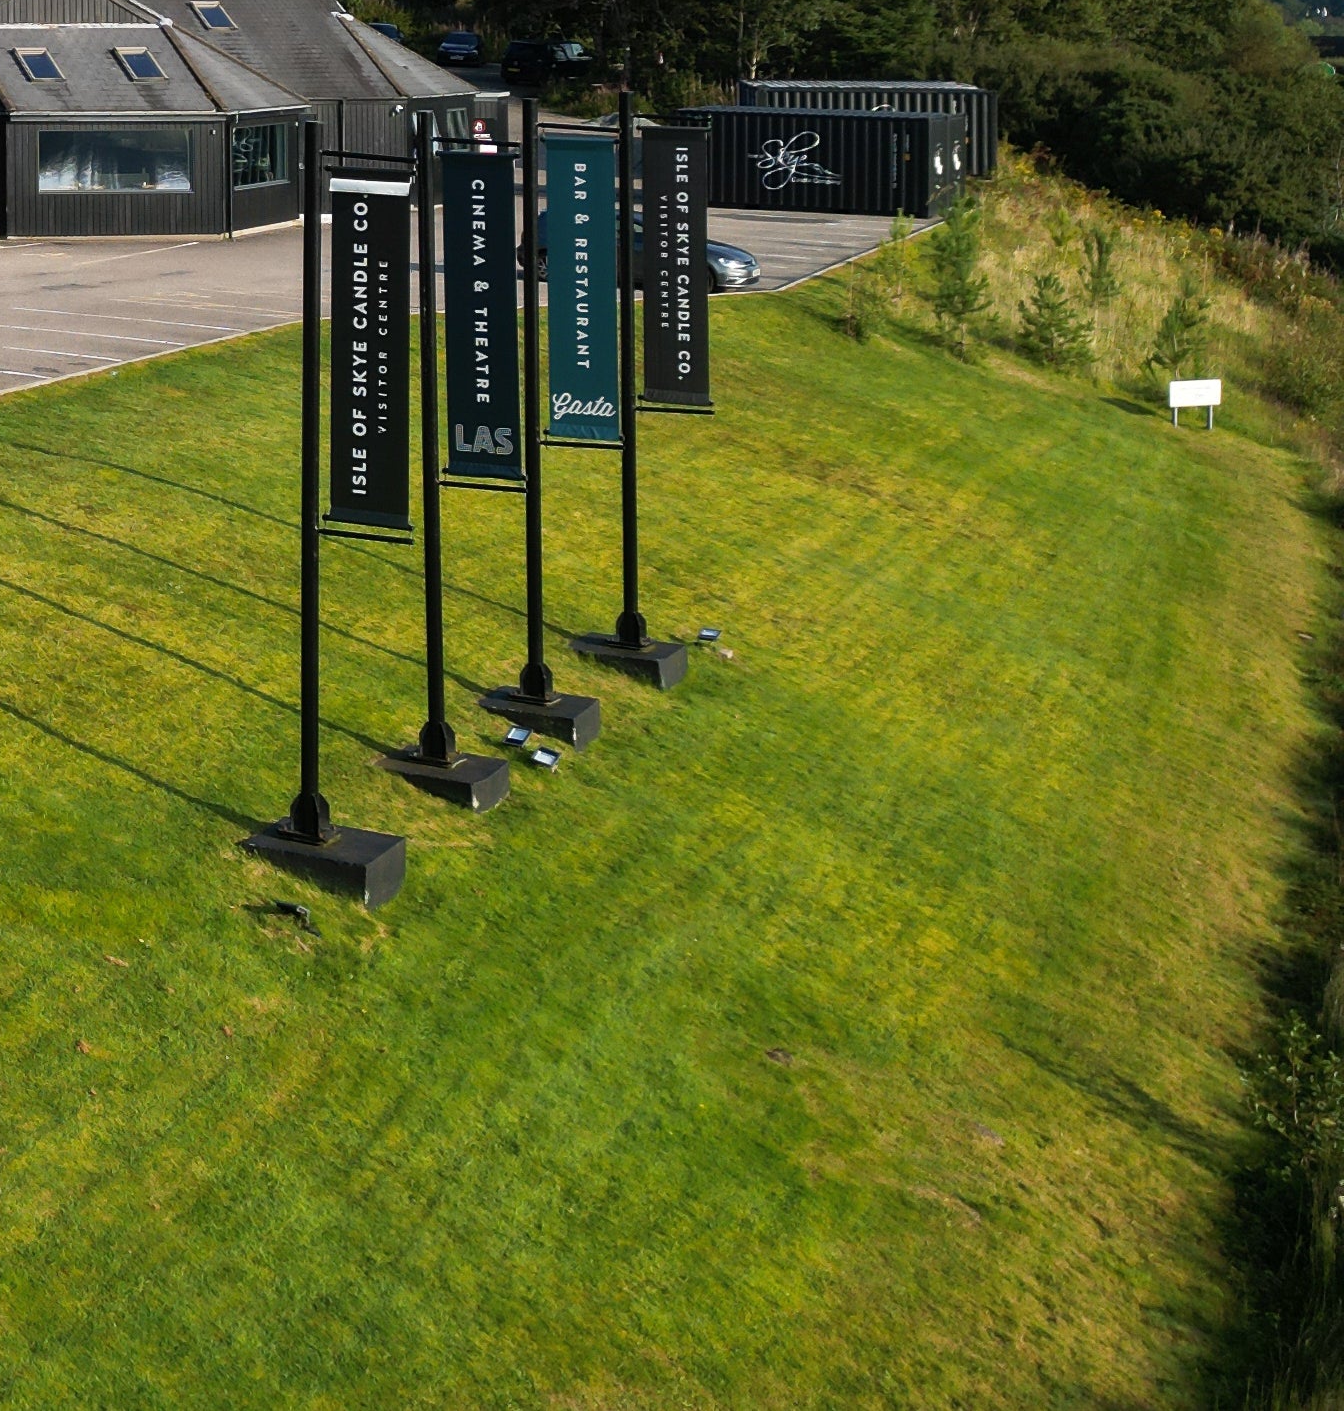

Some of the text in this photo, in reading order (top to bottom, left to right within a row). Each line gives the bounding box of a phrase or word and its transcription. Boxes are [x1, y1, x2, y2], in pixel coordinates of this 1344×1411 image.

[352, 194, 369, 494] ISLE OF SKYE CANDLE CO.
[378, 261, 388, 434] VISITOR CENTRE
[472, 179, 490, 403] CINEMA & THEATRE
[574, 163, 590, 369] BAR & RESTAURANT
[660, 195, 669, 328] VISITOR CENTRE
[675, 147, 691, 380] ISLE OF SKYE CANDLE CO.
[455, 423, 513, 455] LAS
[552, 392, 616, 419] Gasta
